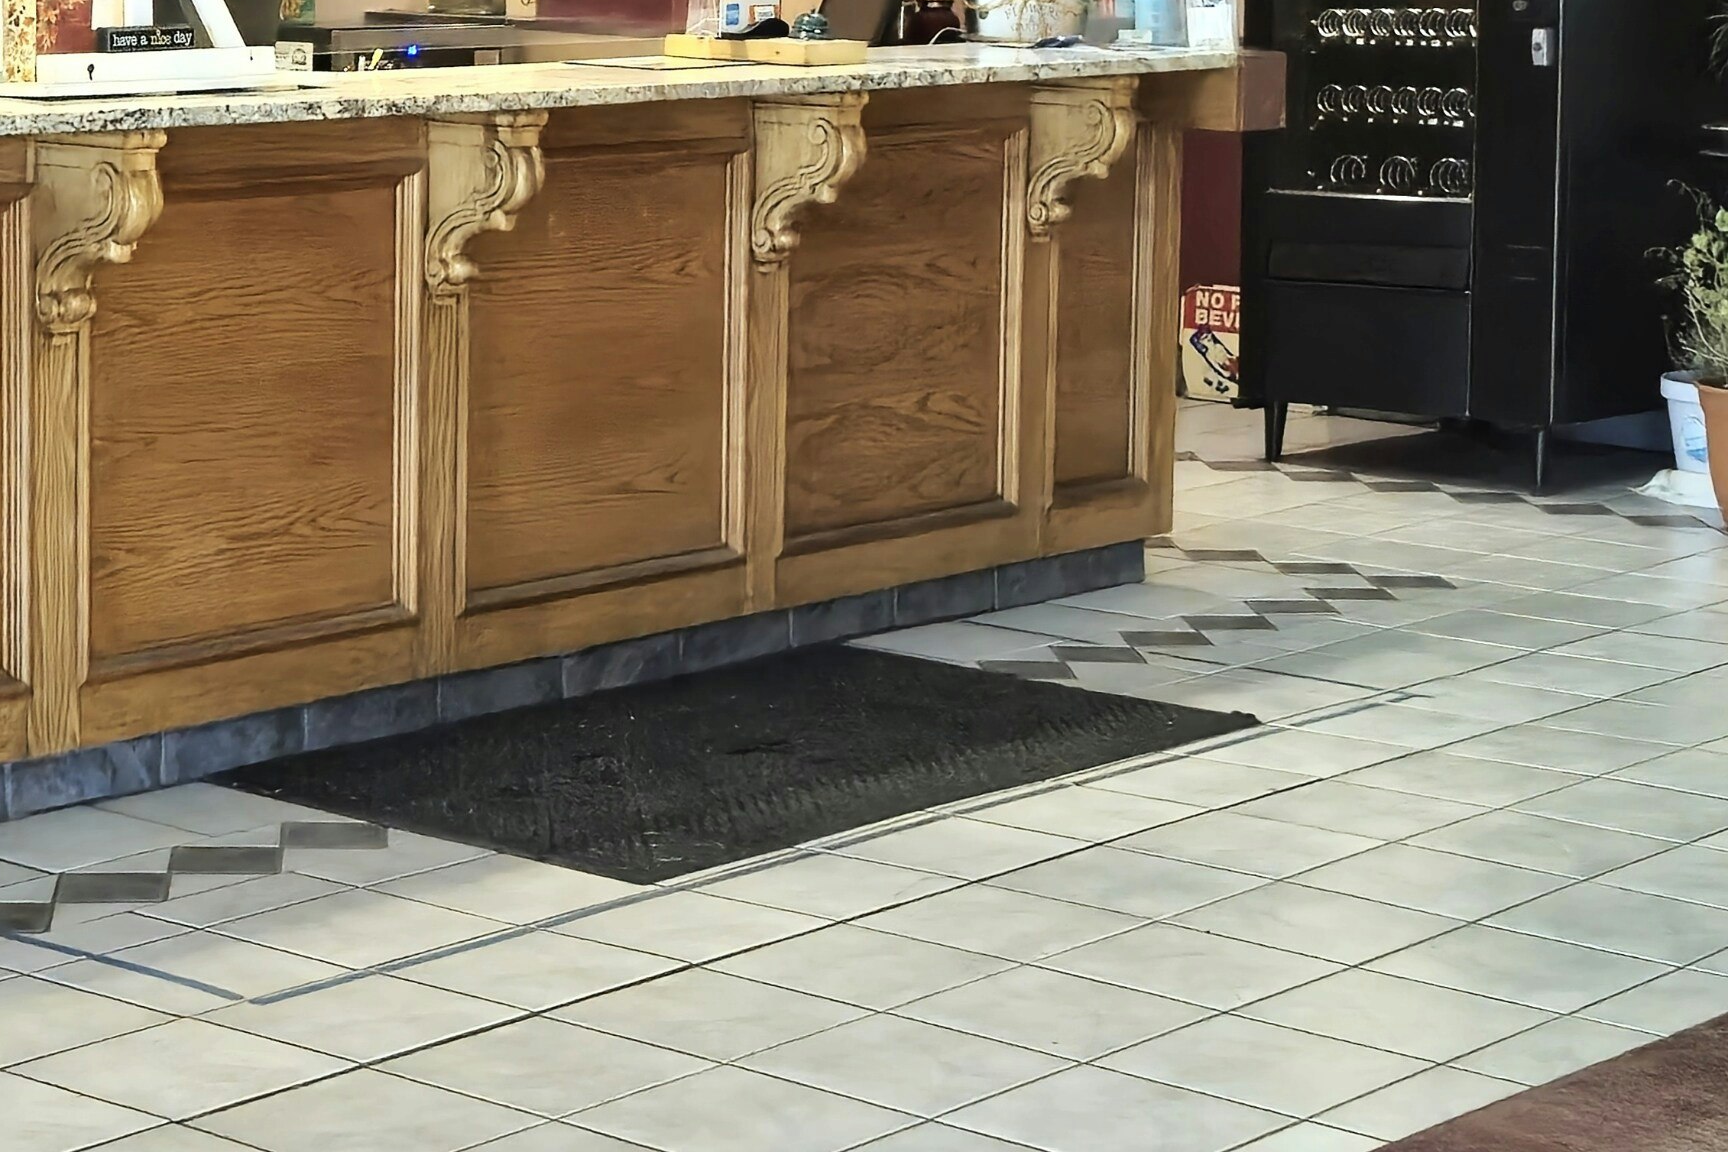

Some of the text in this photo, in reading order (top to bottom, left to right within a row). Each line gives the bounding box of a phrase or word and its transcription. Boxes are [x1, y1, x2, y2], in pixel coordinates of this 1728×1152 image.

[112, 29, 193, 47] have a nice day
[1195, 290, 1225, 309] NO
